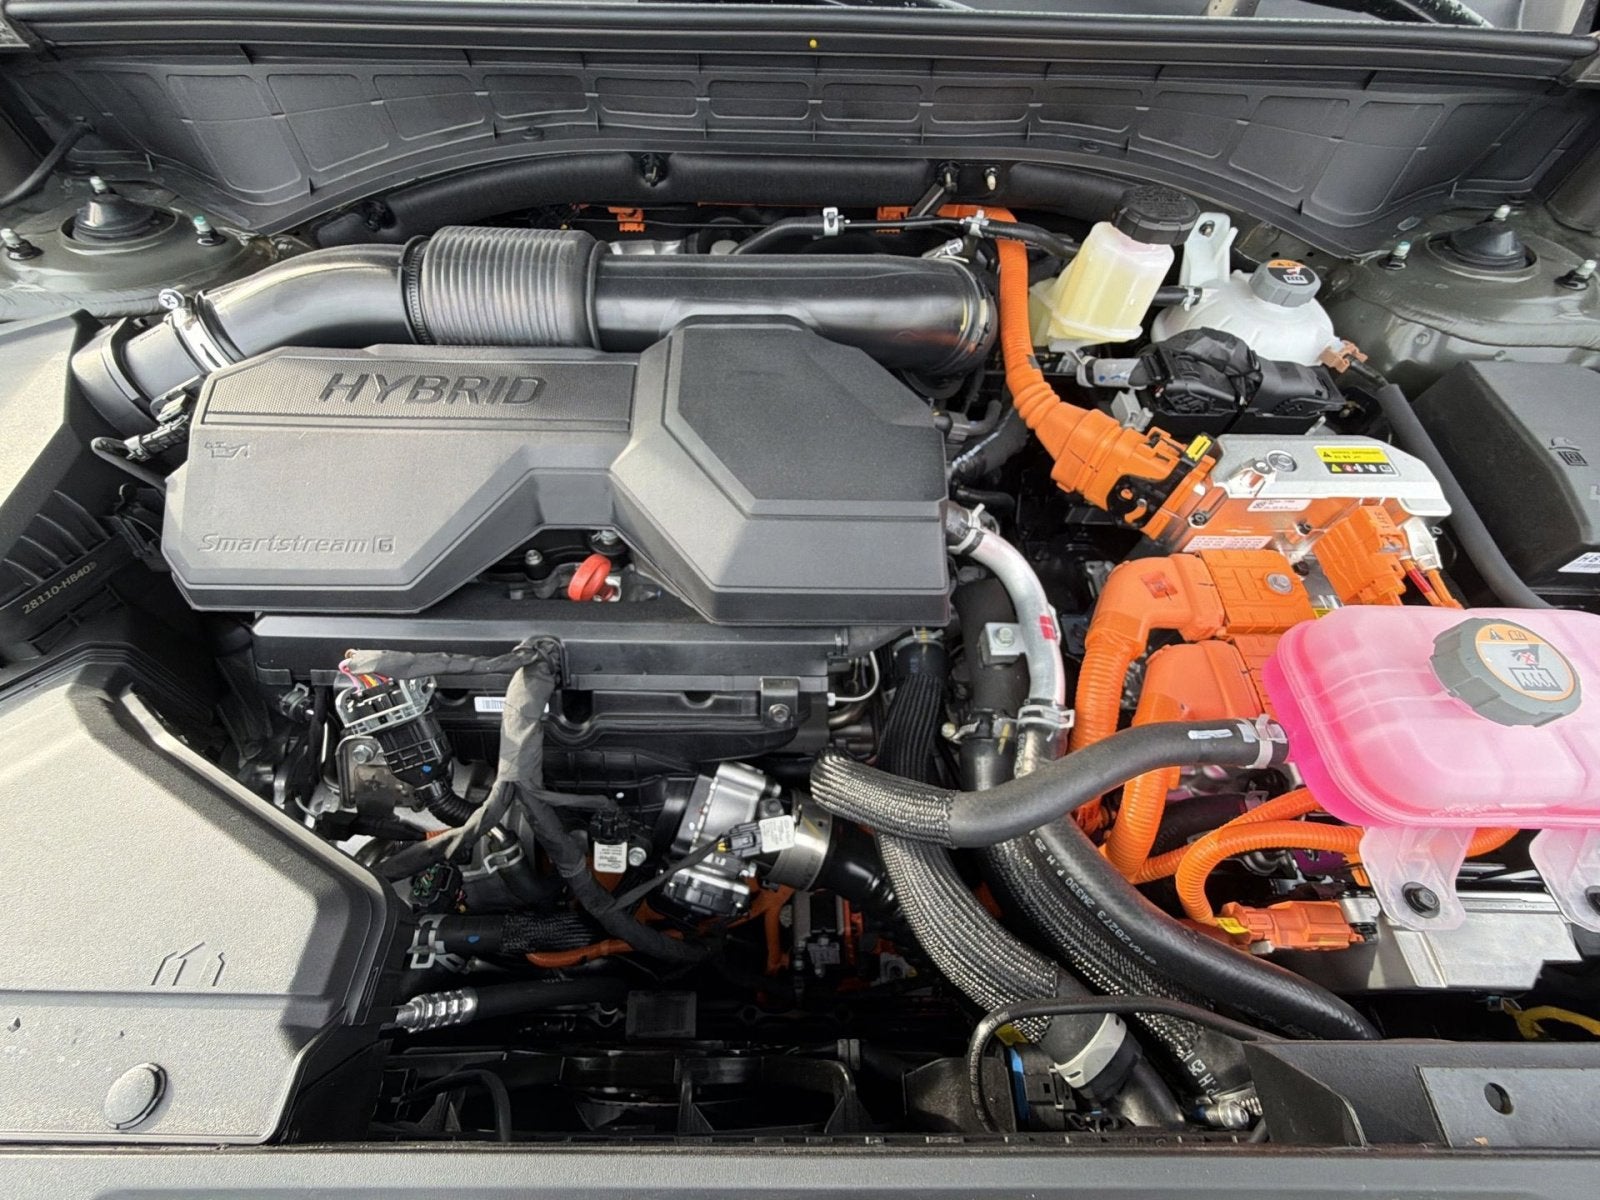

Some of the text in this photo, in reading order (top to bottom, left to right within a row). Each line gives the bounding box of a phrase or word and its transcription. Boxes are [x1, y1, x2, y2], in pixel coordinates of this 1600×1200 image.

[317, 372, 548, 406] HYBRID
[201, 532, 369, 554] Smartstream
[1064, 876, 1096, 909] 2M330
